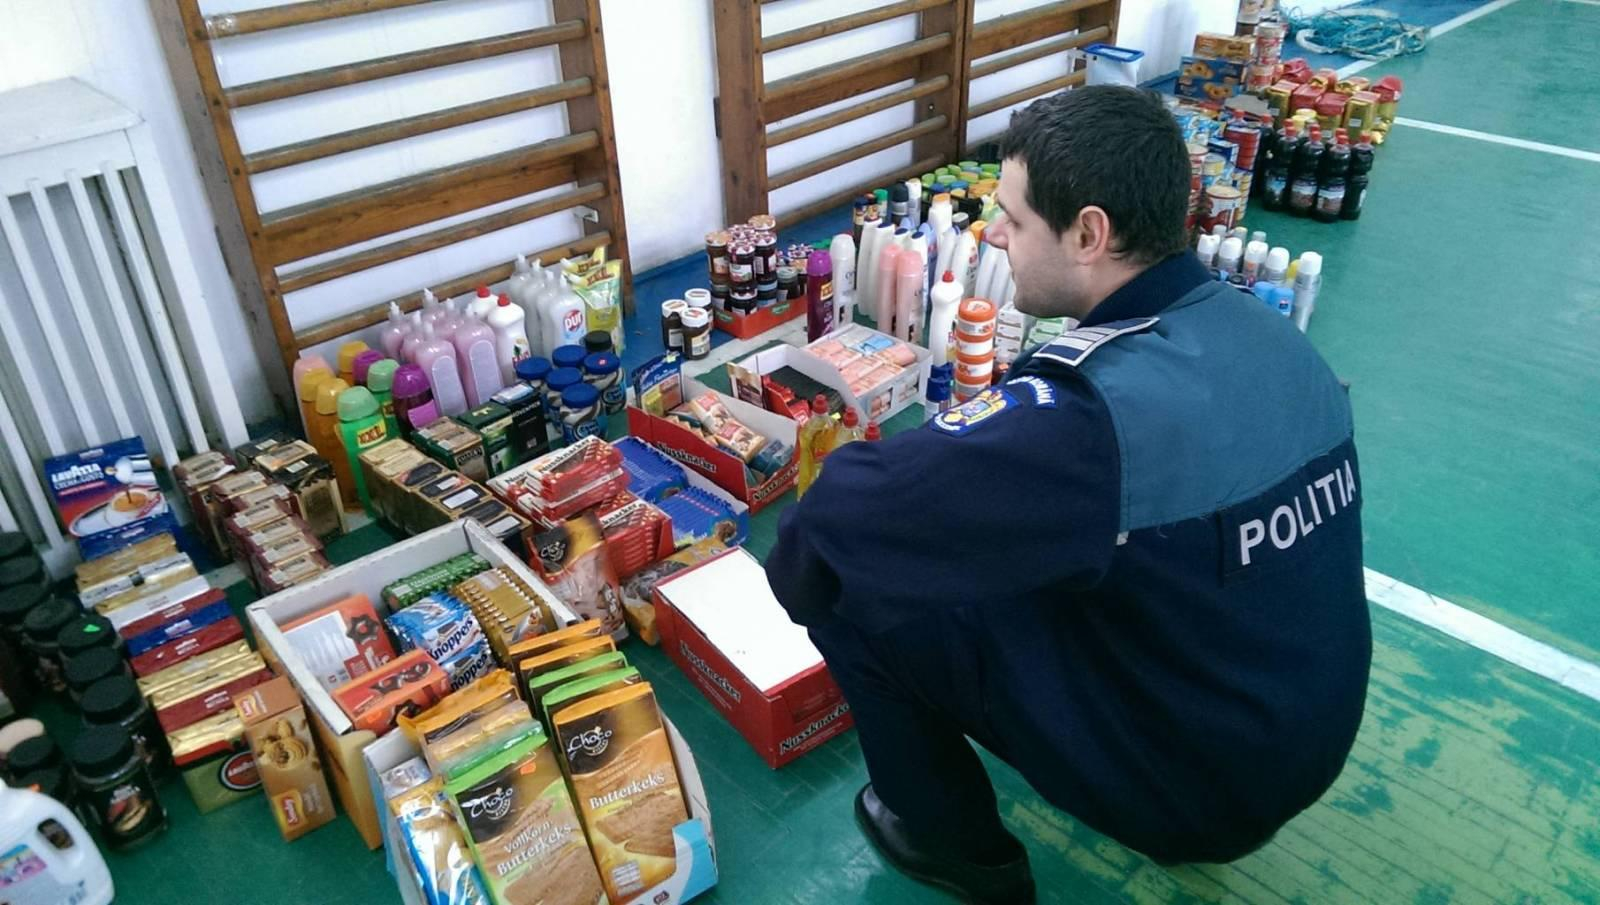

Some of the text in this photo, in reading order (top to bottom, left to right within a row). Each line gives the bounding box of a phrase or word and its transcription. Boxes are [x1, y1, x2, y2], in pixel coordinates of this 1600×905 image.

[564, 314, 583, 332] pur
[1240, 459, 1356, 566] POLITIA
[779, 702, 850, 756] Nussknacke
[589, 771, 666, 810] Butterkeks
[497, 824, 572, 876] Butterkeks
